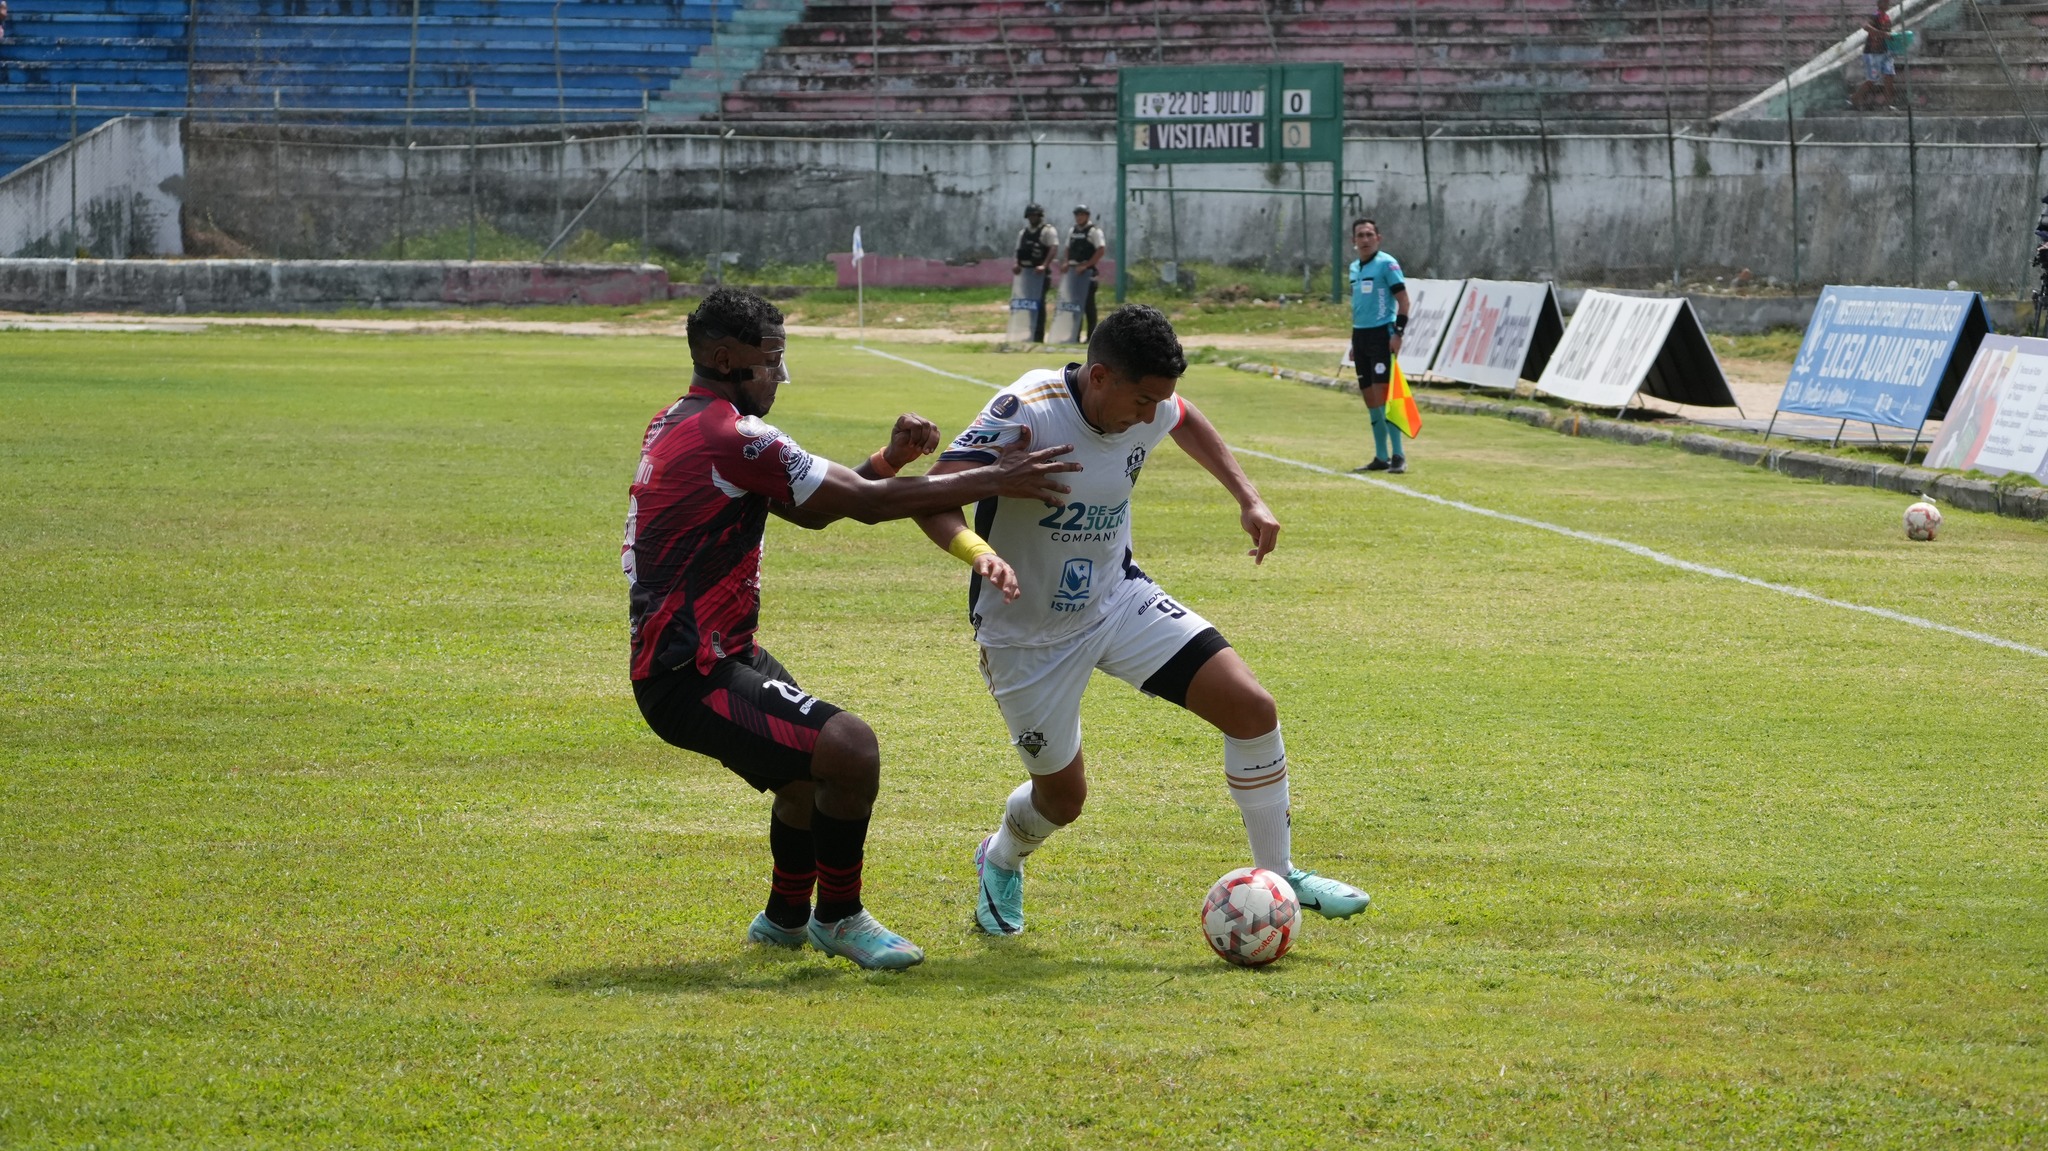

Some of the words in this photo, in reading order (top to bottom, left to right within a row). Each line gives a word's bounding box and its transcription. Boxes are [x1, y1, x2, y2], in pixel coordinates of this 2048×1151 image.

[1168, 92, 1187, 115] 22
[1191, 92, 1209, 114] DE
[1213, 90, 1253, 114] JULIO
[1290, 92, 1303, 113] 0
[1157, 122, 1253, 149] VISITANTE
[1287, 127, 1301, 146] 0
[1833, 300, 1877, 325] INSTITUTO
[1870, 301, 1912, 327] SUPERIOR
[1038, 501, 1087, 531] 22
[1087, 505, 1108, 516] DE
[1083, 508, 1128, 531] JULIO
[1051, 530, 1119, 543] COMPANY
[1156, 598, 1187, 620] 9
[1250, 930, 1278, 957] molten
